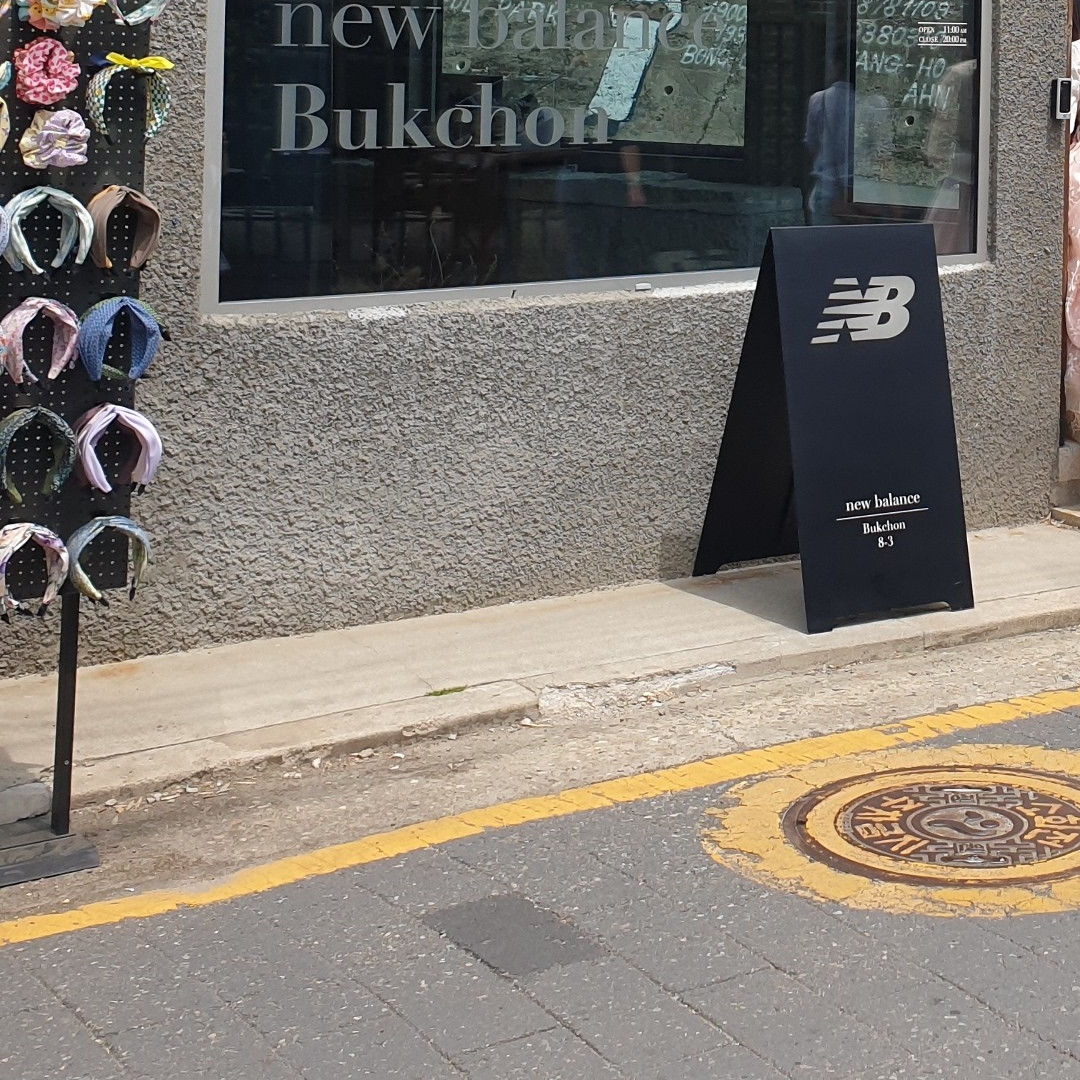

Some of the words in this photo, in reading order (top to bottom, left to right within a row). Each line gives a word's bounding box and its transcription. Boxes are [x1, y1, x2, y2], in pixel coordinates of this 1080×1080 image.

[274, 1, 441, 50] new
[918, 26, 936, 34] OPEN
[272, 82, 614, 152] Bukchon
[845, 499, 872, 512] new
[874, 491, 921, 509] balance
[862, 518, 907, 535] Bukchon
[877, 536, 894, 549] 8-3
